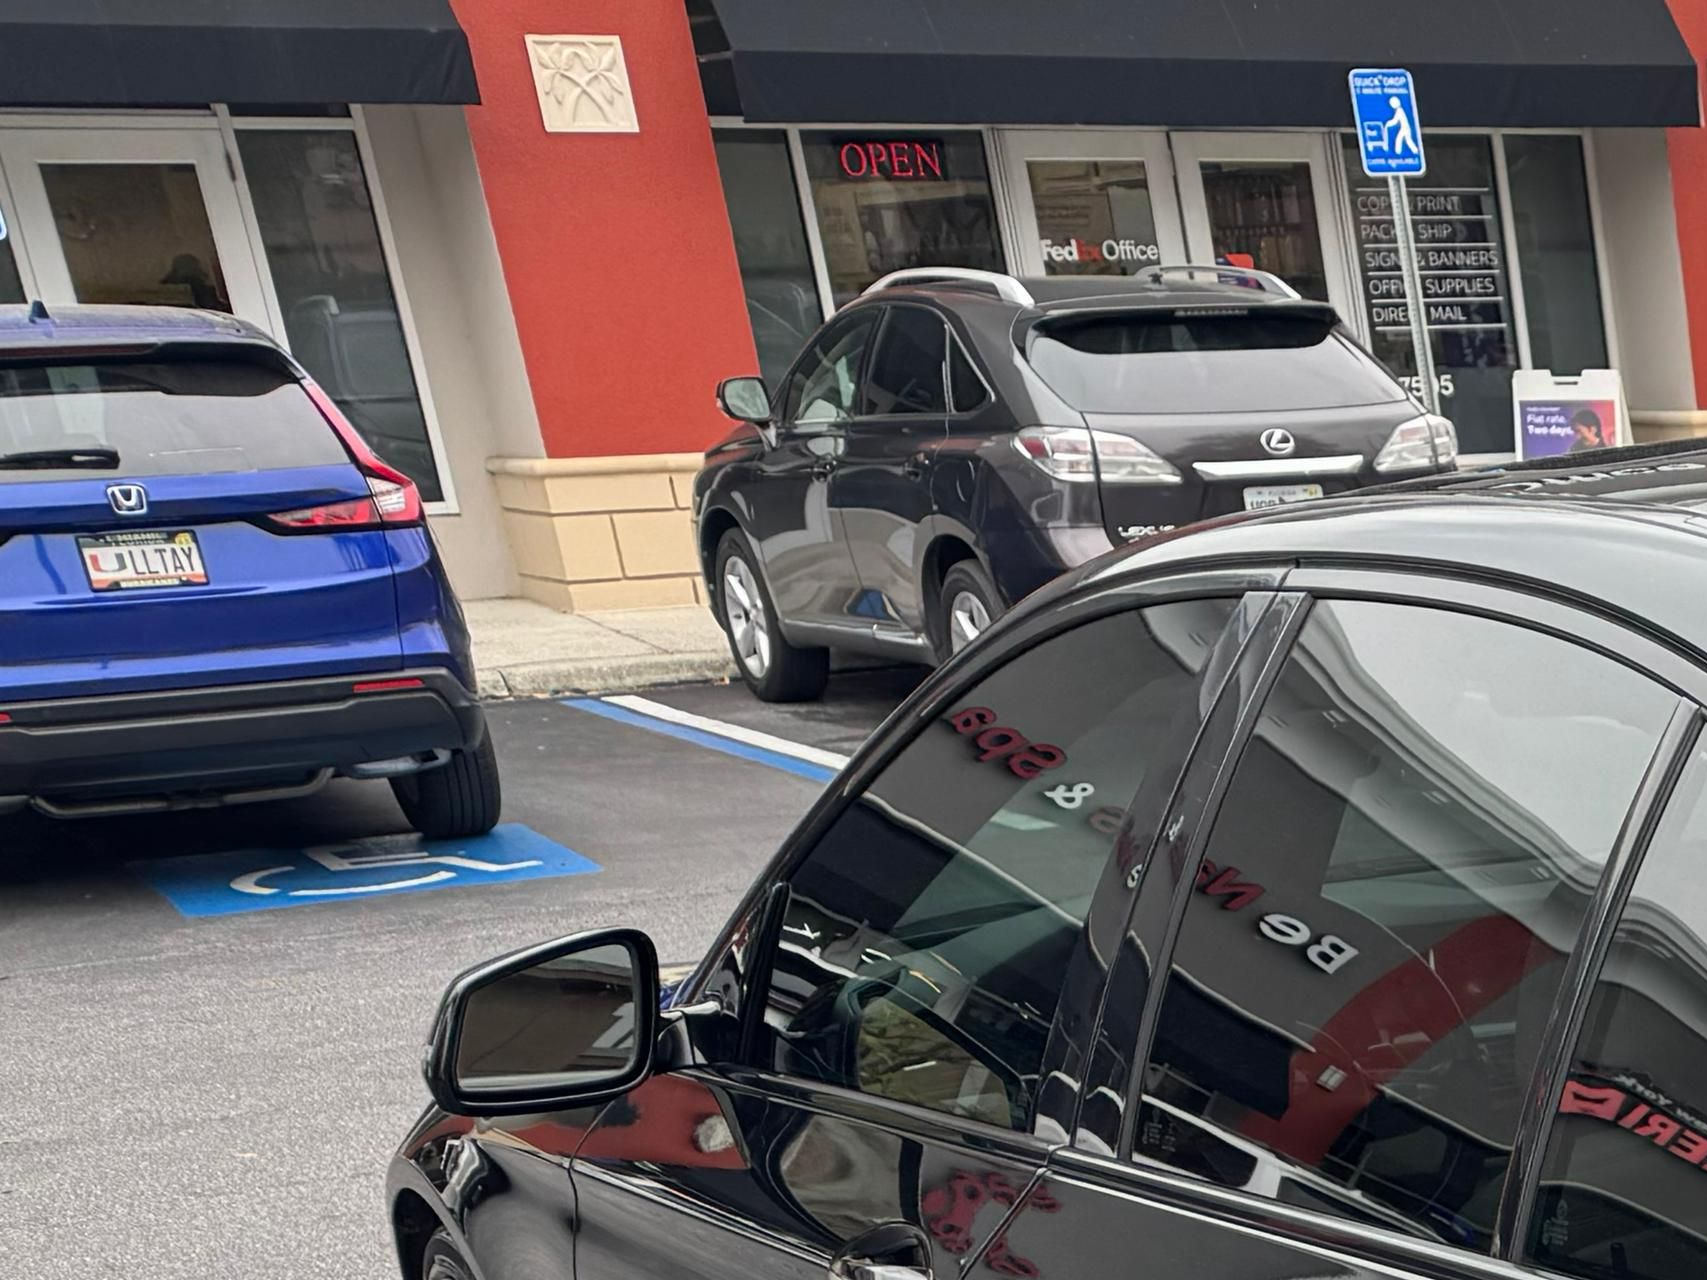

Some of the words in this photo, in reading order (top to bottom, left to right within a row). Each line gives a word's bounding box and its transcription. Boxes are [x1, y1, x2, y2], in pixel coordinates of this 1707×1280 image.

[840, 143, 942, 177] OPEN
[1357, 196, 1392, 212] COP
[1417, 196, 1459, 211] PRINT
[1418, 224, 1452, 239] SHIP
[1102, 239, 1159, 260] Office
[1365, 252, 1403, 268] SIGN
[1428, 251, 1499, 267] BANNERS
[1369, 279, 1404, 295] OFFI
[1425, 278, 1495, 295] SUPPLIES
[1373, 306, 1408, 322] DIRE
[1430, 306, 1468, 321] MAIL
[1398, 374, 1455, 397] 755
